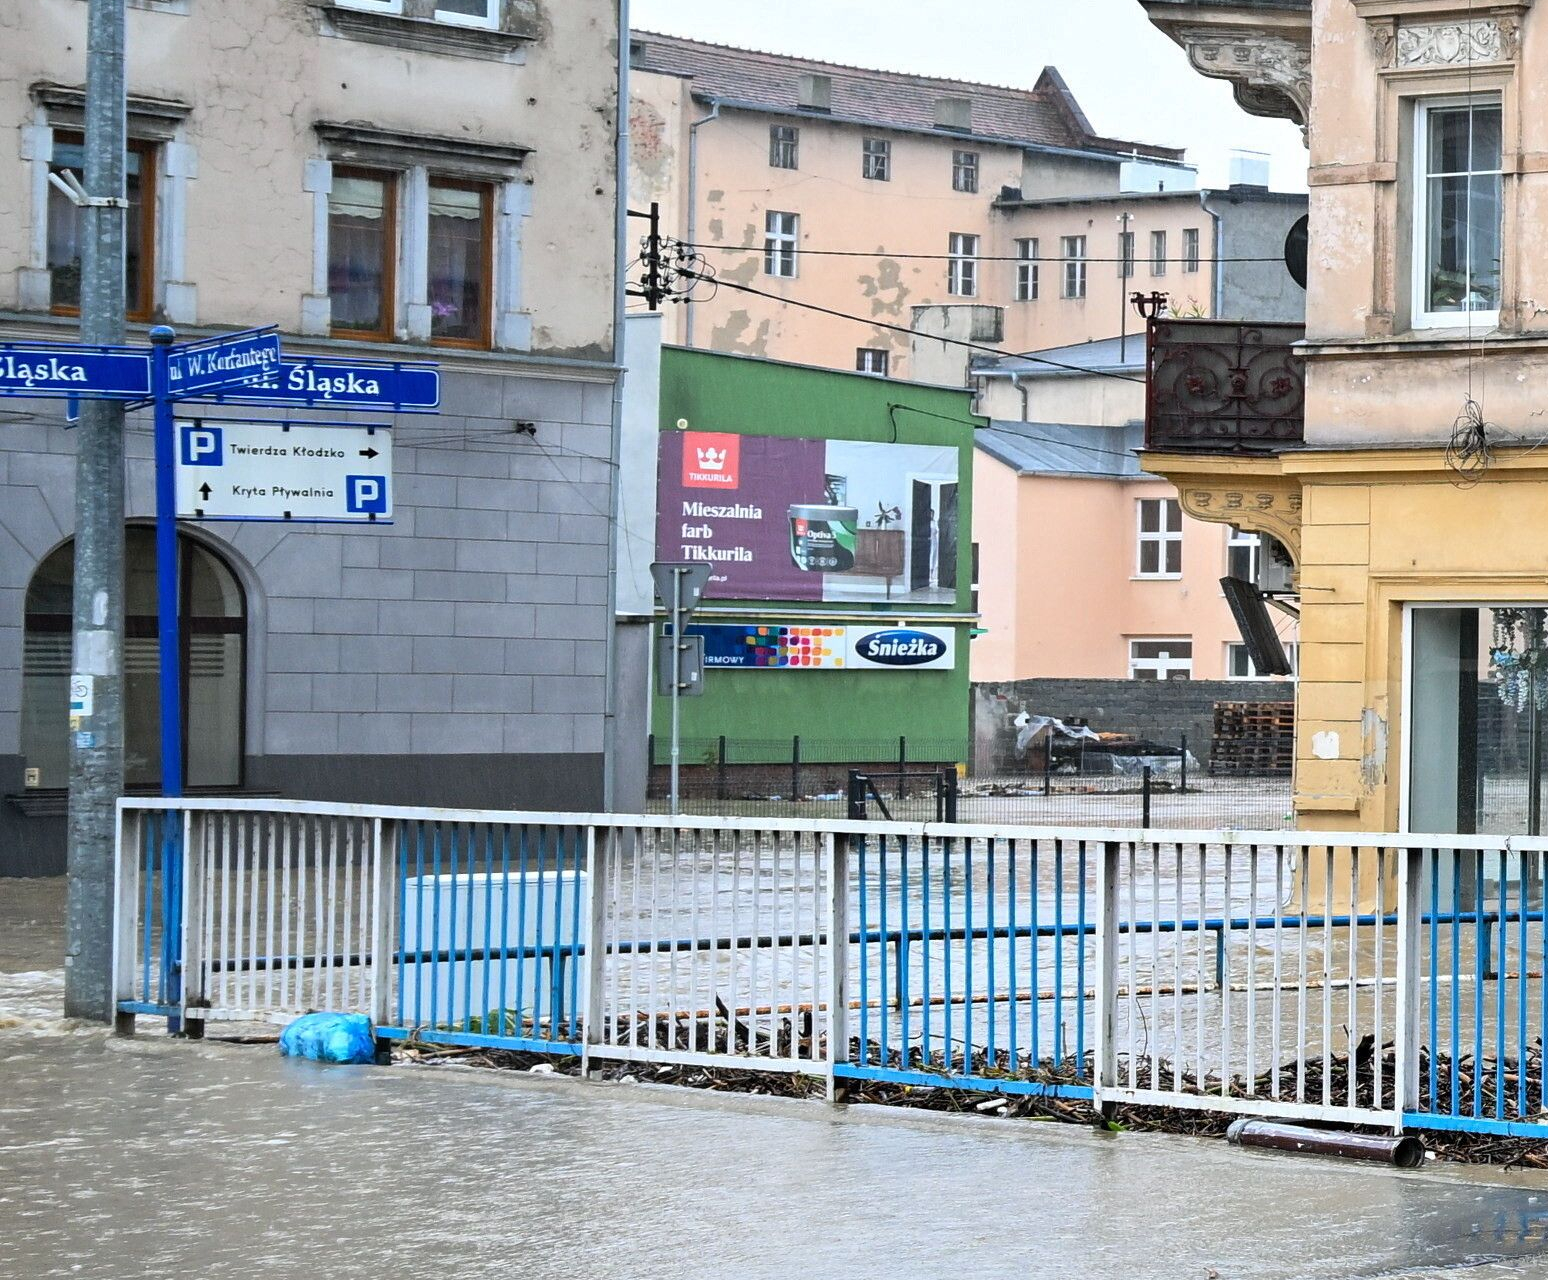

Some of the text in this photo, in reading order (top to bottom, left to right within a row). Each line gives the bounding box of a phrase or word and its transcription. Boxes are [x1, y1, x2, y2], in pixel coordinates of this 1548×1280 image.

[287, 365, 380, 399] Śląska
[230, 444, 287, 456] Twierdza
[293, 446, 345, 458] Kłodzko
[688, 472, 733, 483] TIKKURILA
[232, 485, 266, 499] Kryta
[272, 486, 334, 499] Pływalnia
[681, 501, 763, 519] Mieszalnia
[681, 523, 713, 539] farb
[680, 545, 753, 562] Tikkurila
[868, 634, 938, 656] Śnieżka
[704, 656, 744, 664] IRMOWY
